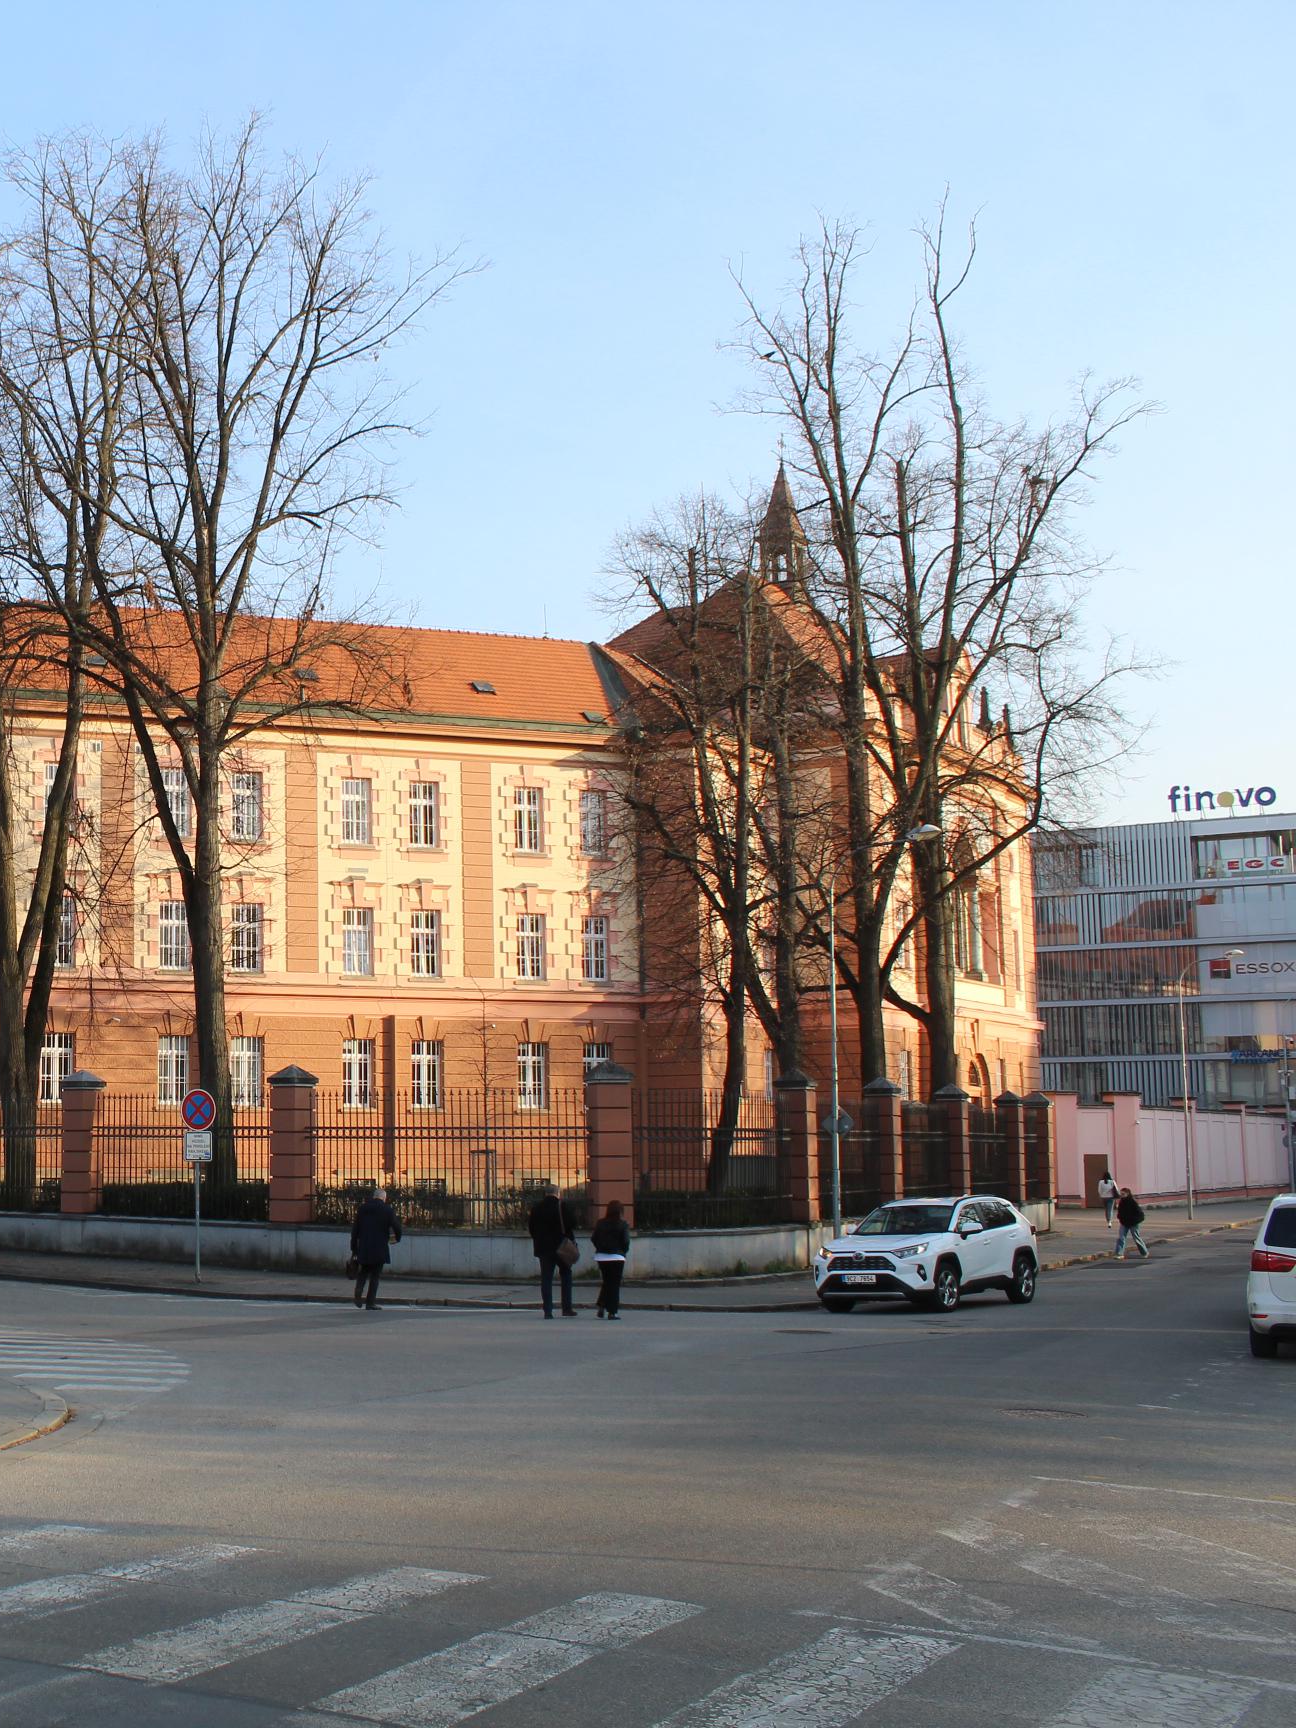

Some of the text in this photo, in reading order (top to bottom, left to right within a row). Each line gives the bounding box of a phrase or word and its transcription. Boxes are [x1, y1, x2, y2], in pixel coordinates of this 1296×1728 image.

[1167, 785, 1277, 813] finovo
[1227, 858, 1285, 870] EGC
[1236, 962, 1295, 974] ESSOX
